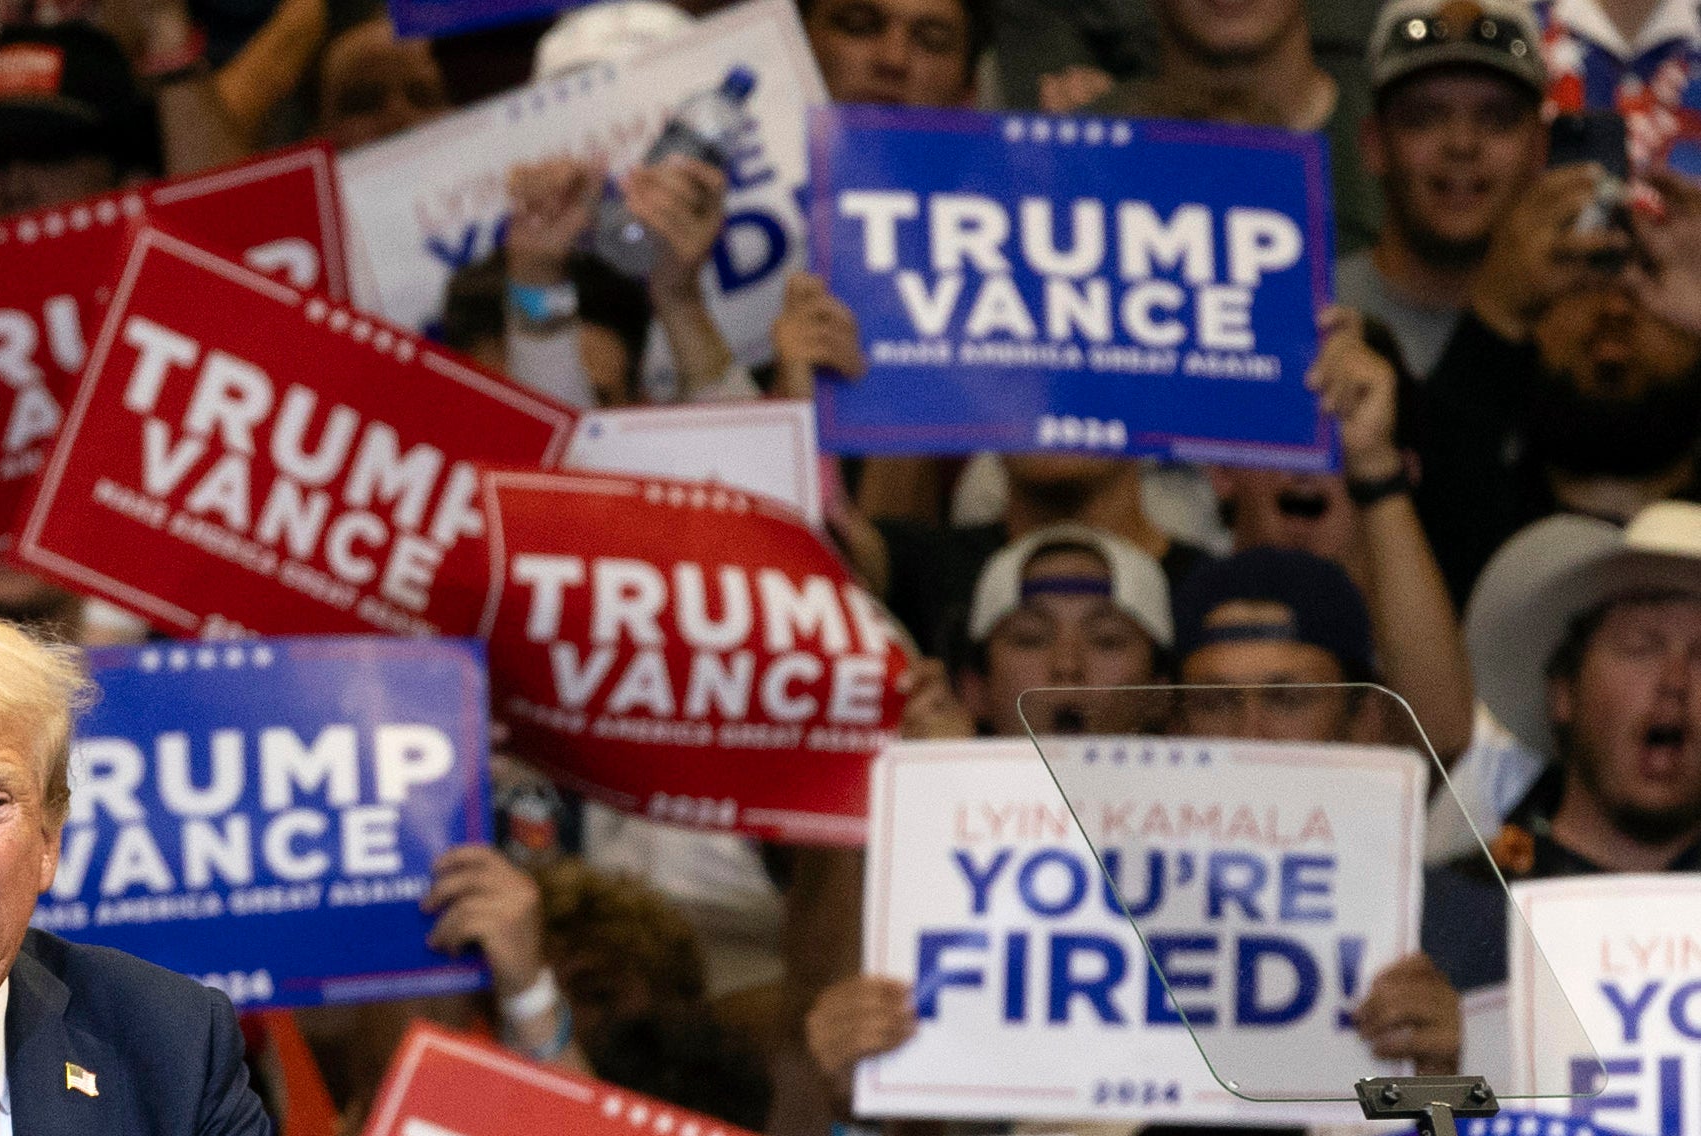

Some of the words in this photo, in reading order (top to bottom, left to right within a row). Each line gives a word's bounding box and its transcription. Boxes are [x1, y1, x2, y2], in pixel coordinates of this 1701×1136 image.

[839, 189, 1304, 287] TRUMP
[897, 268, 1254, 351] VANCE
[142, 415, 446, 614] VANCE
[549, 640, 889, 725] VANCE
[67, 723, 456, 825] RUMP
[1103, 804, 1336, 845] KAMALA
[952, 848, 1337, 922] YOU'RE
[202, 968, 276, 1004] 024
[914, 929, 1370, 1030] FIRED!
